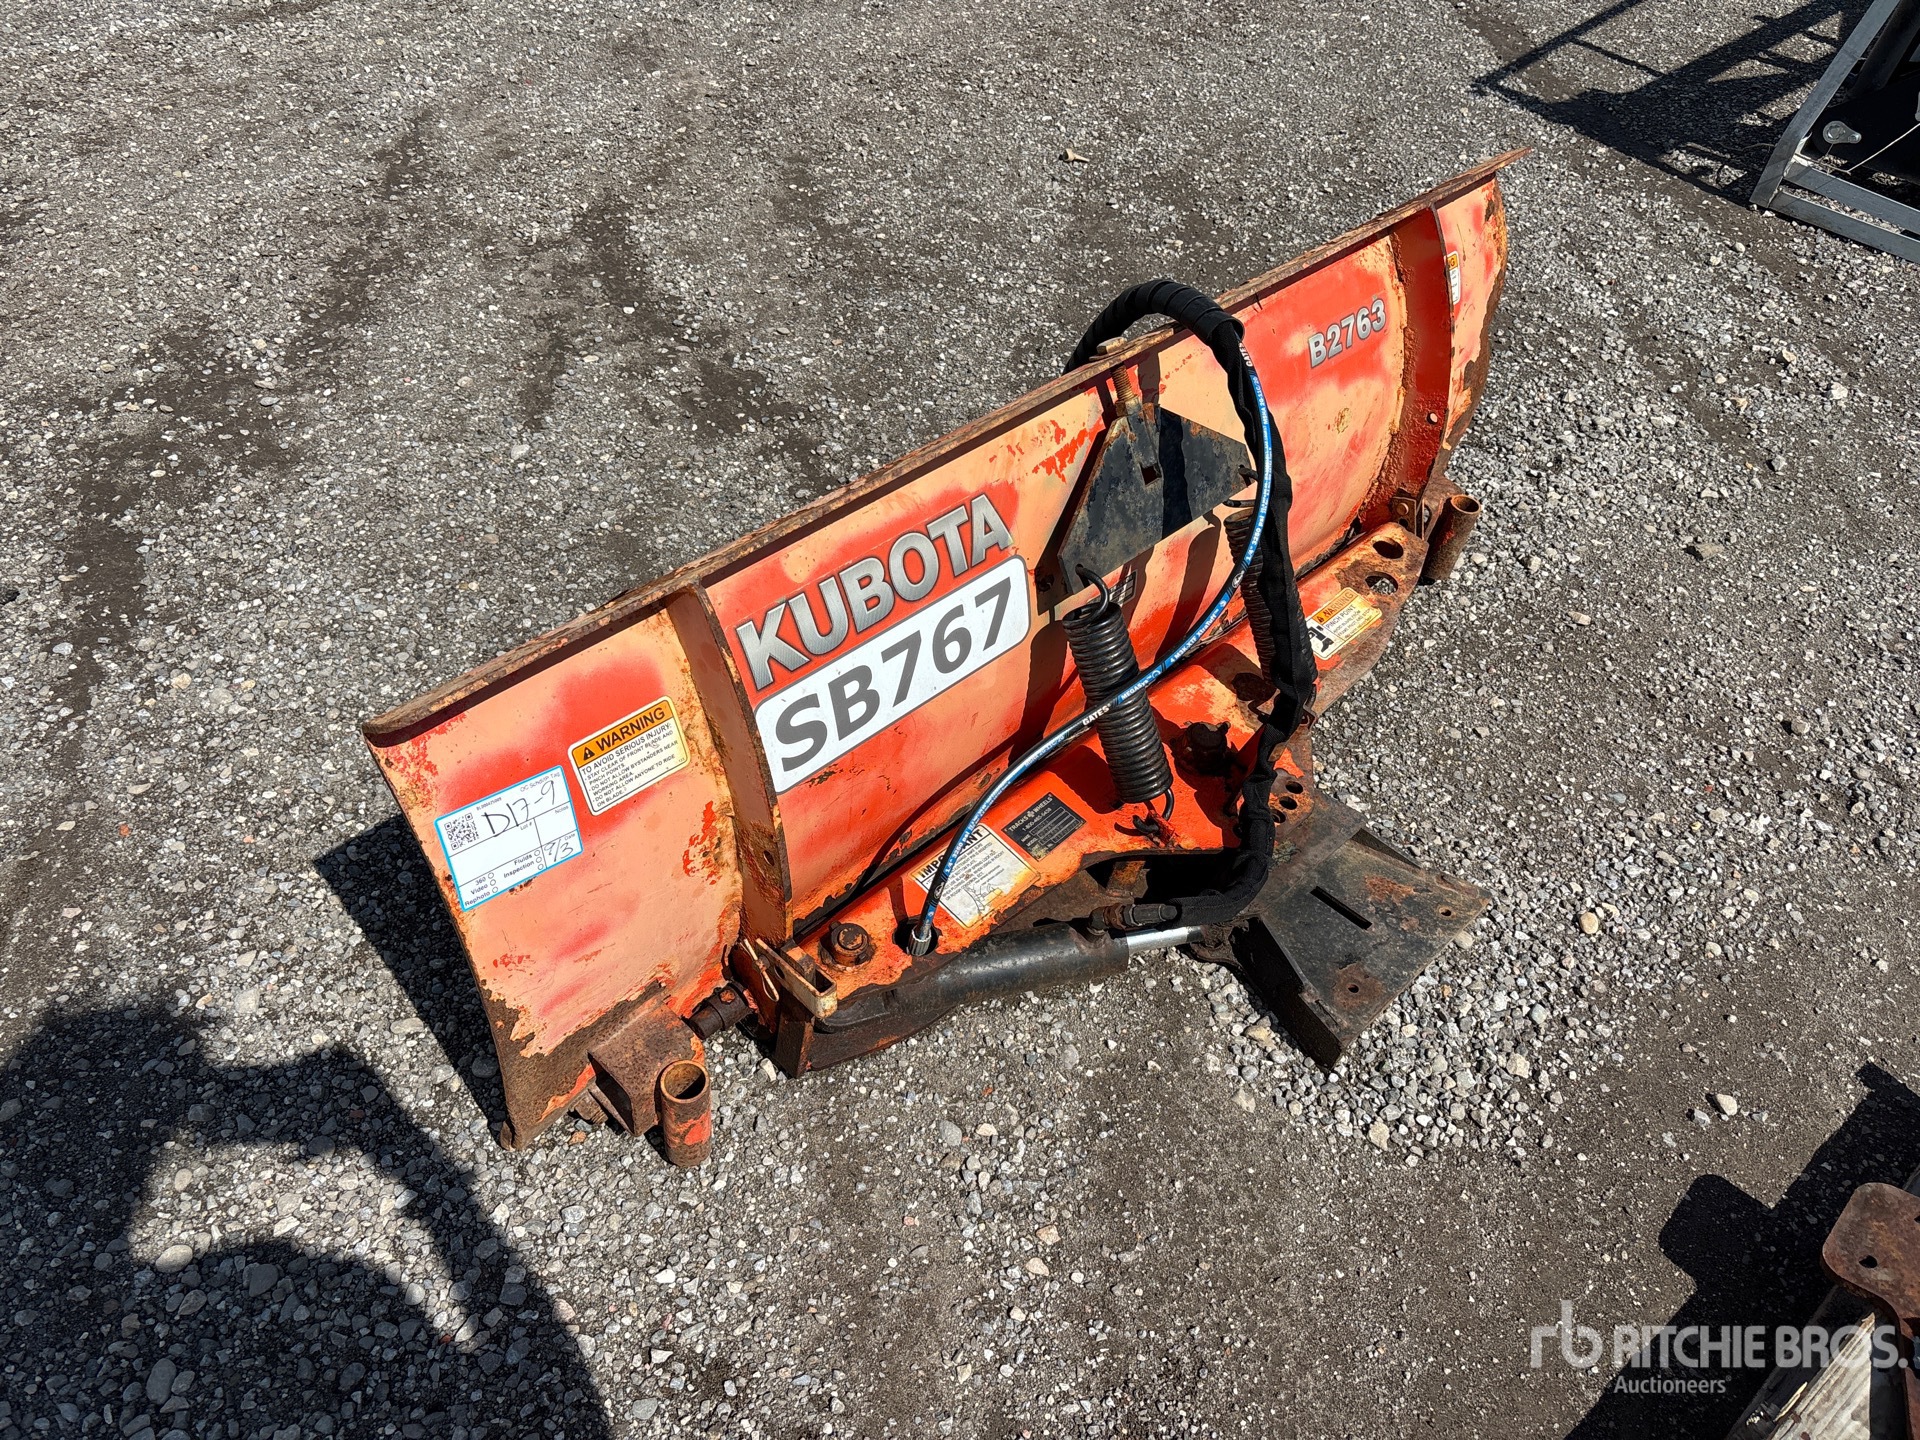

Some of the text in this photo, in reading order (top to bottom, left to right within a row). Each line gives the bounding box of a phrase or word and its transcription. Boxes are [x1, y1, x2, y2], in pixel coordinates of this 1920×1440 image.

[1308, 298, 1386, 369] B2763
[736, 493, 1013, 691] KUBOTA
[775, 577, 1011, 772] SB767
[596, 707, 665, 752] WARNING
[582, 766, 592, 775] TO
[593, 753, 615, 769] AVOID
[616, 737, 646, 756] SERIOUS
[588, 770, 600, 780] STAY
[600, 761, 618, 774] CLEAR
[627, 747, 644, 760] FRONT
[645, 737, 661, 748] BLADE
[662, 730, 674, 739] AND
[600, 776, 611, 786] NOT
[611, 767, 630, 780] ALLOW
[630, 748, 663, 770] BYSTANDERS
[664, 740, 679, 751] NEAR
[589, 773, 606, 785] PINCH
[593, 780, 618, 796] WORKING
[603, 787, 615, 797] NOT
[615, 778, 634, 791] ALLOW
[634, 766, 656, 781] ANYONE
[1008, 815, 1028, 832] TRACKS
[1033, 796, 1053, 813] WHEELS
[564, 833, 576, 841] Date
[503, 860, 535, 879] Inspection
[514, 854, 533, 866] Fluids
[470, 883, 488, 895] Video
[475, 876, 487, 886] 360
[464, 891, 491, 907] Rephoto
